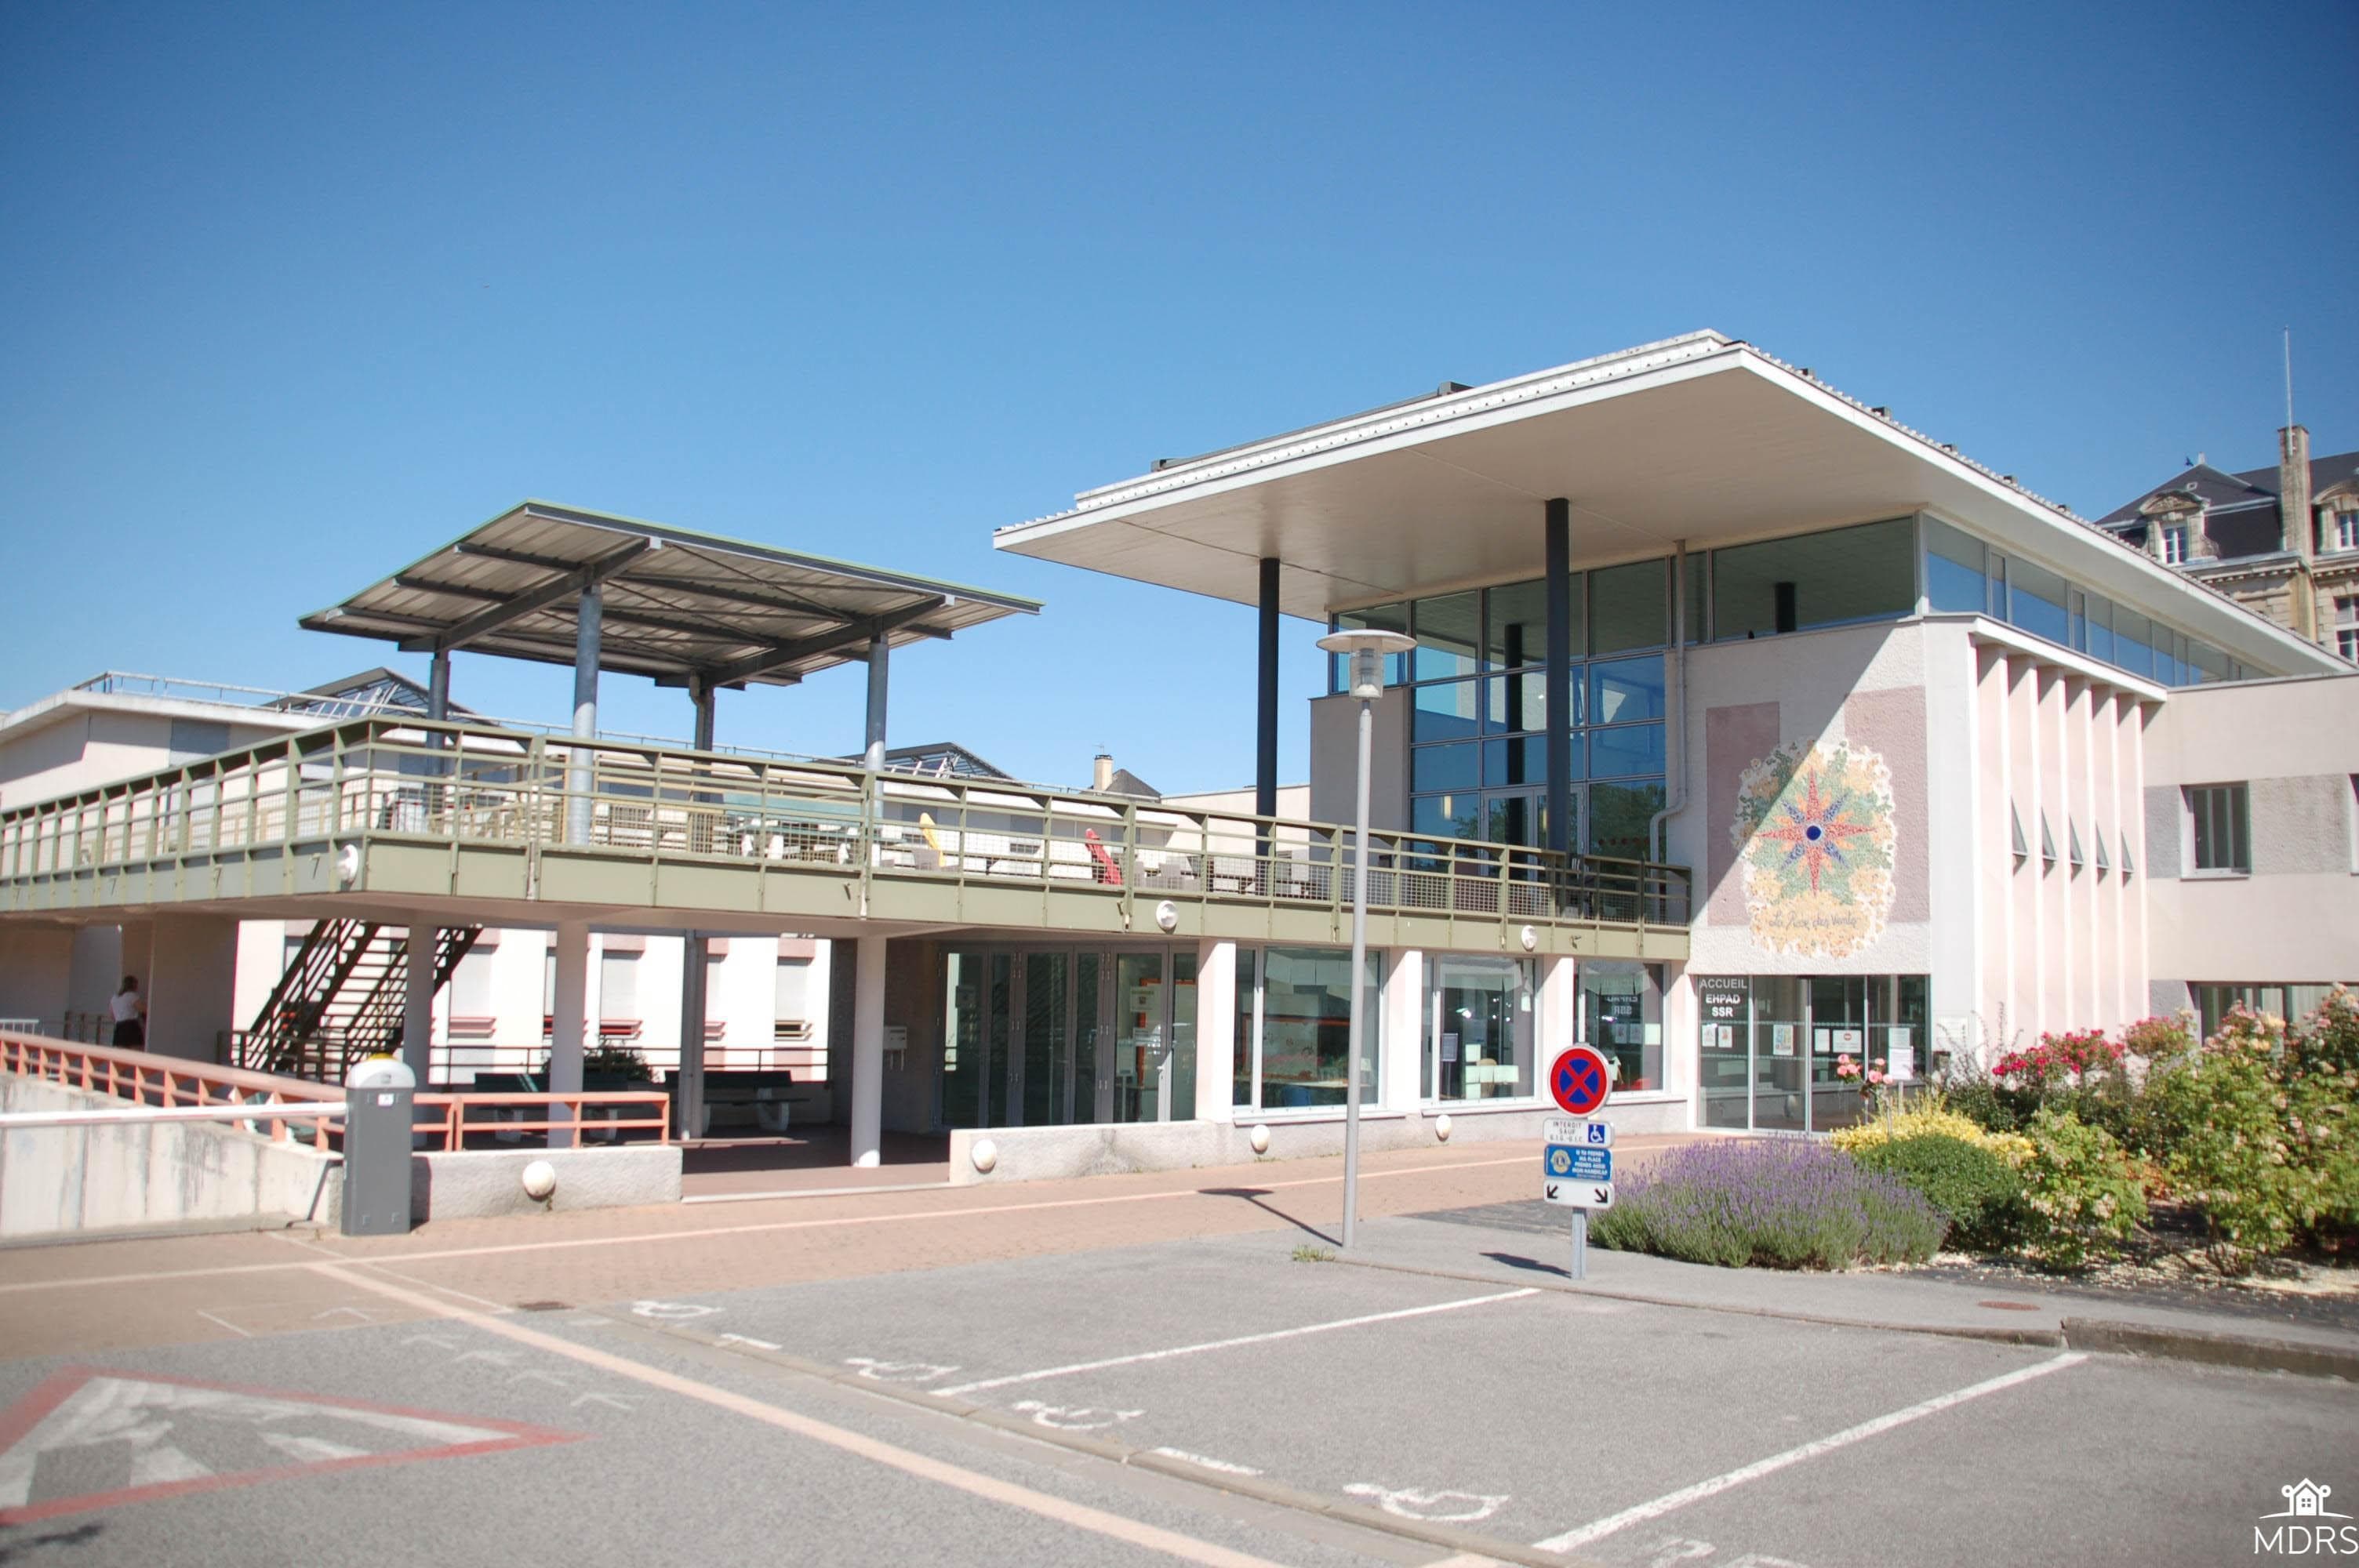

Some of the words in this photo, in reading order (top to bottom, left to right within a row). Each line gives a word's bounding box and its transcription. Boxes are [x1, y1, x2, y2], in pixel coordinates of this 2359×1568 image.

[1699, 978, 1747, 989] ACCUEIL
[1706, 994, 1741, 1004] EHPAD
[1711, 1006, 1734, 1018] SSR
